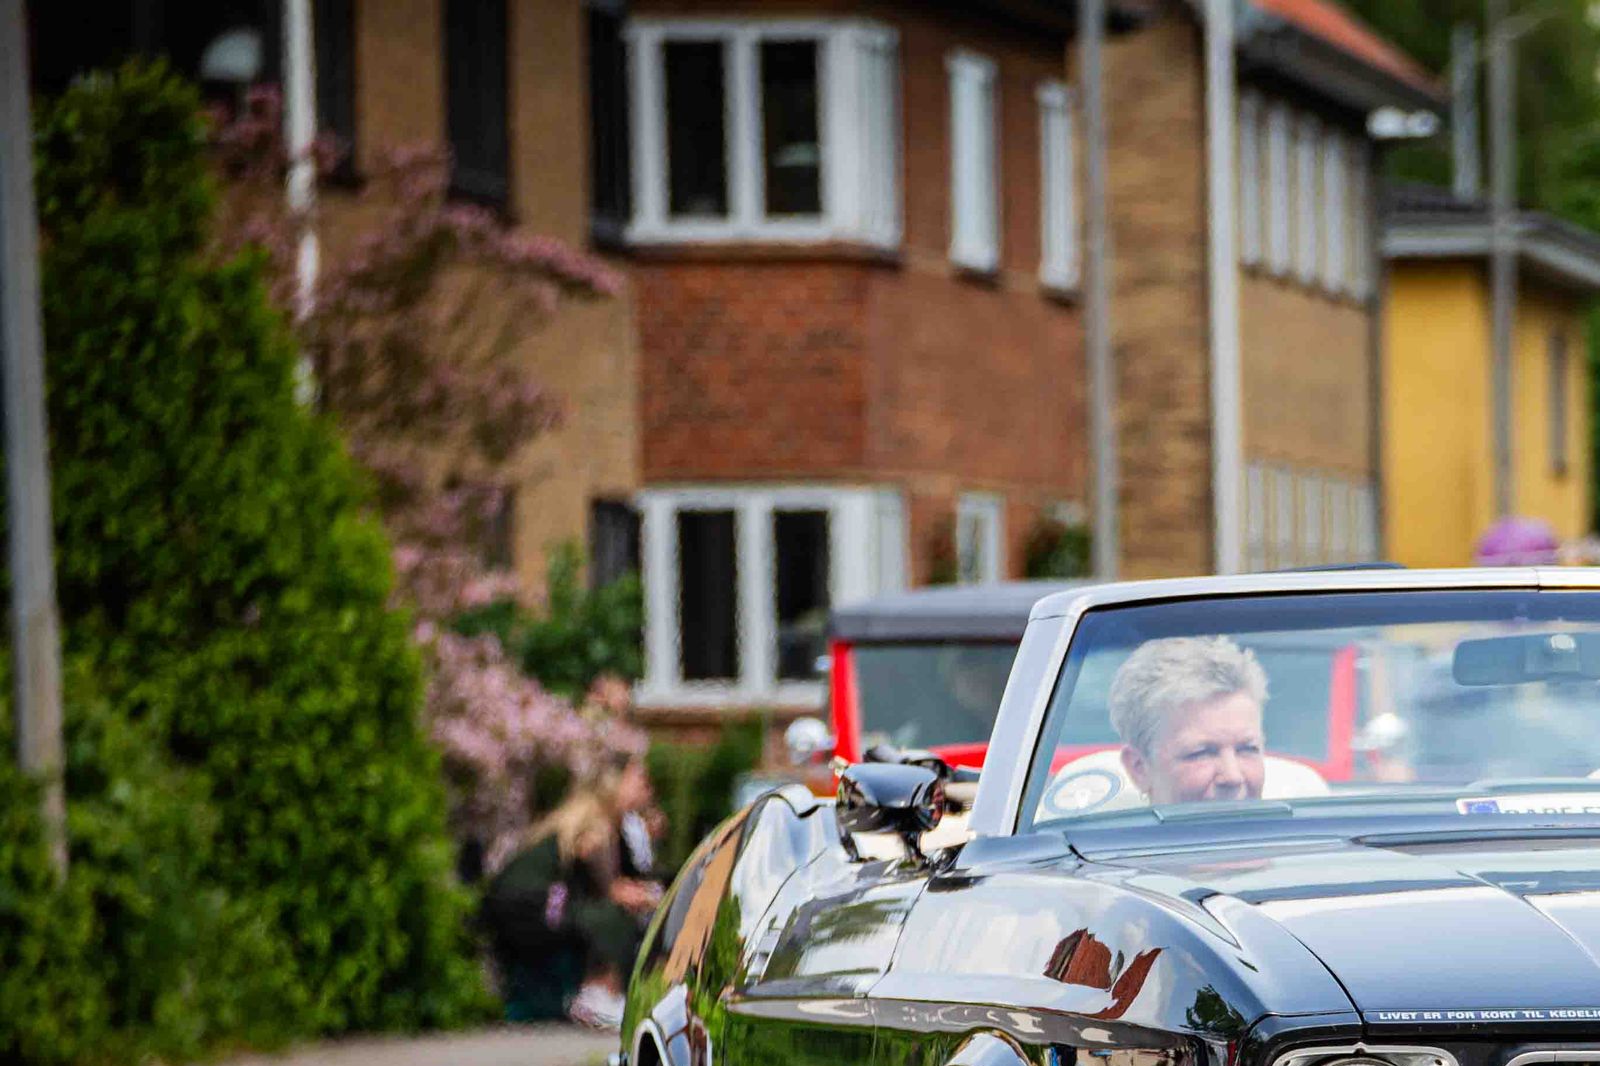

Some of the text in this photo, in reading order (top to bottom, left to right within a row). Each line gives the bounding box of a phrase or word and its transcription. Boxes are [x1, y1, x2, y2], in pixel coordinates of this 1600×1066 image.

[1380, 1011, 1418, 1020] LIVET
[1423, 1011, 1442, 1020] ER
[1447, 1011, 1475, 1020] FOR
[1481, 1010, 1518, 1019] KORT
[1522, 1010, 1545, 1019] TIL
